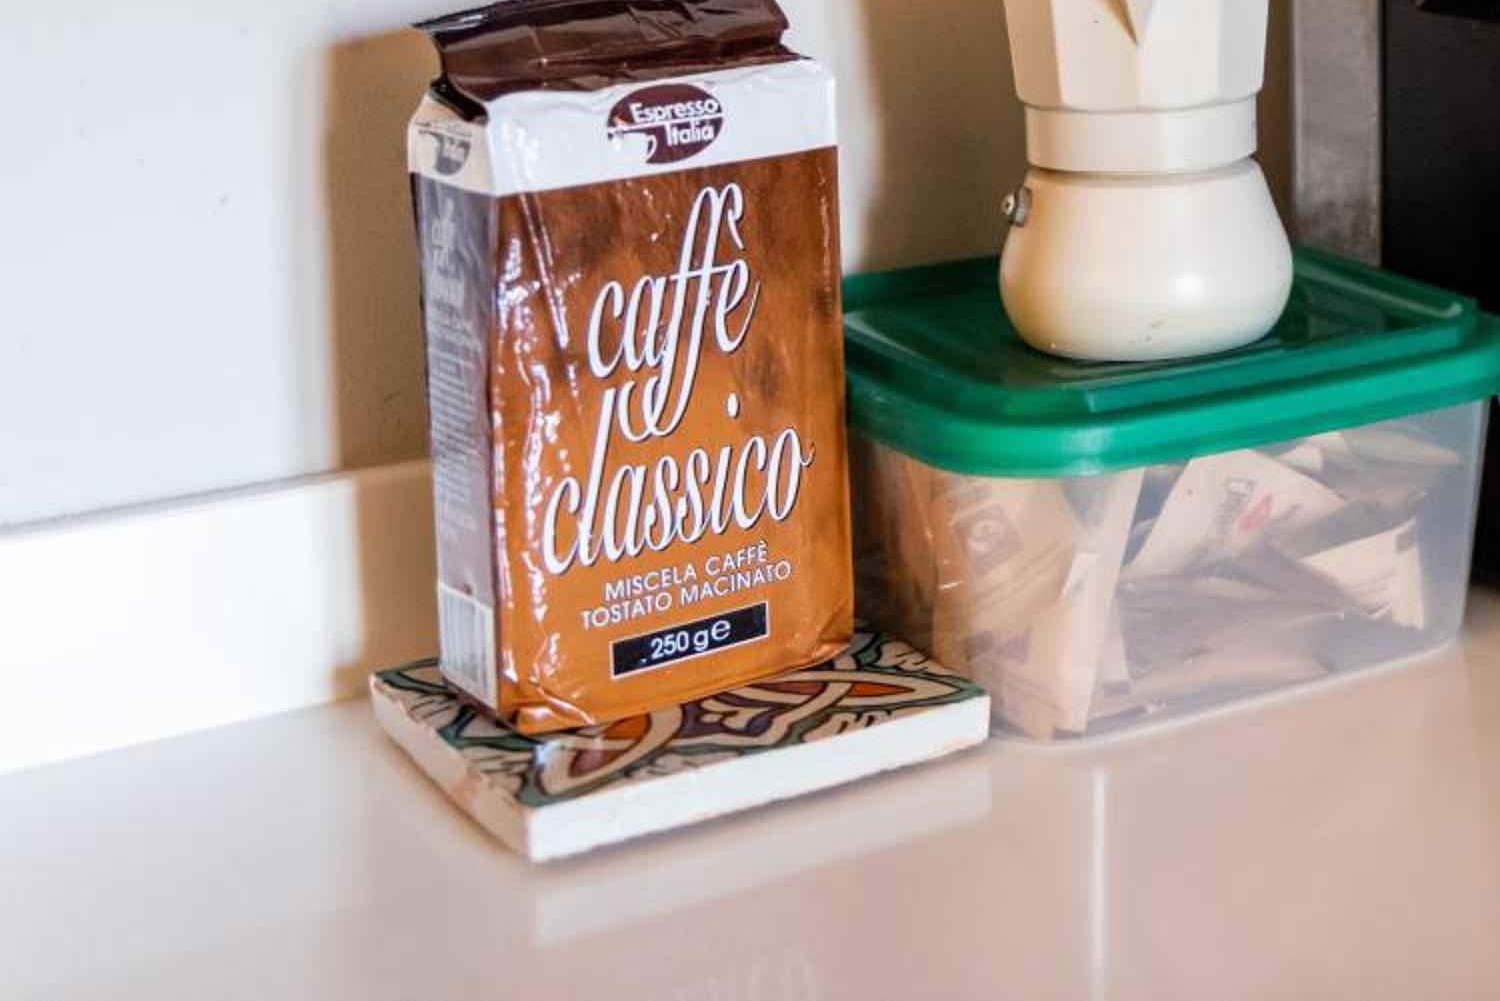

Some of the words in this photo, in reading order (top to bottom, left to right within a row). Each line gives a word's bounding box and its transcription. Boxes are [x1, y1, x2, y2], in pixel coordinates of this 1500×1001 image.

[629, 99, 719, 124] Espresso
[664, 119, 715, 146] Italia
[541, 388, 815, 576] classico
[581, 591, 672, 630] TOSTATO
[681, 560, 791, 605] MACINATO
[605, 563, 697, 601] MISCELA
[705, 540, 768, 576] CAFFÈ
